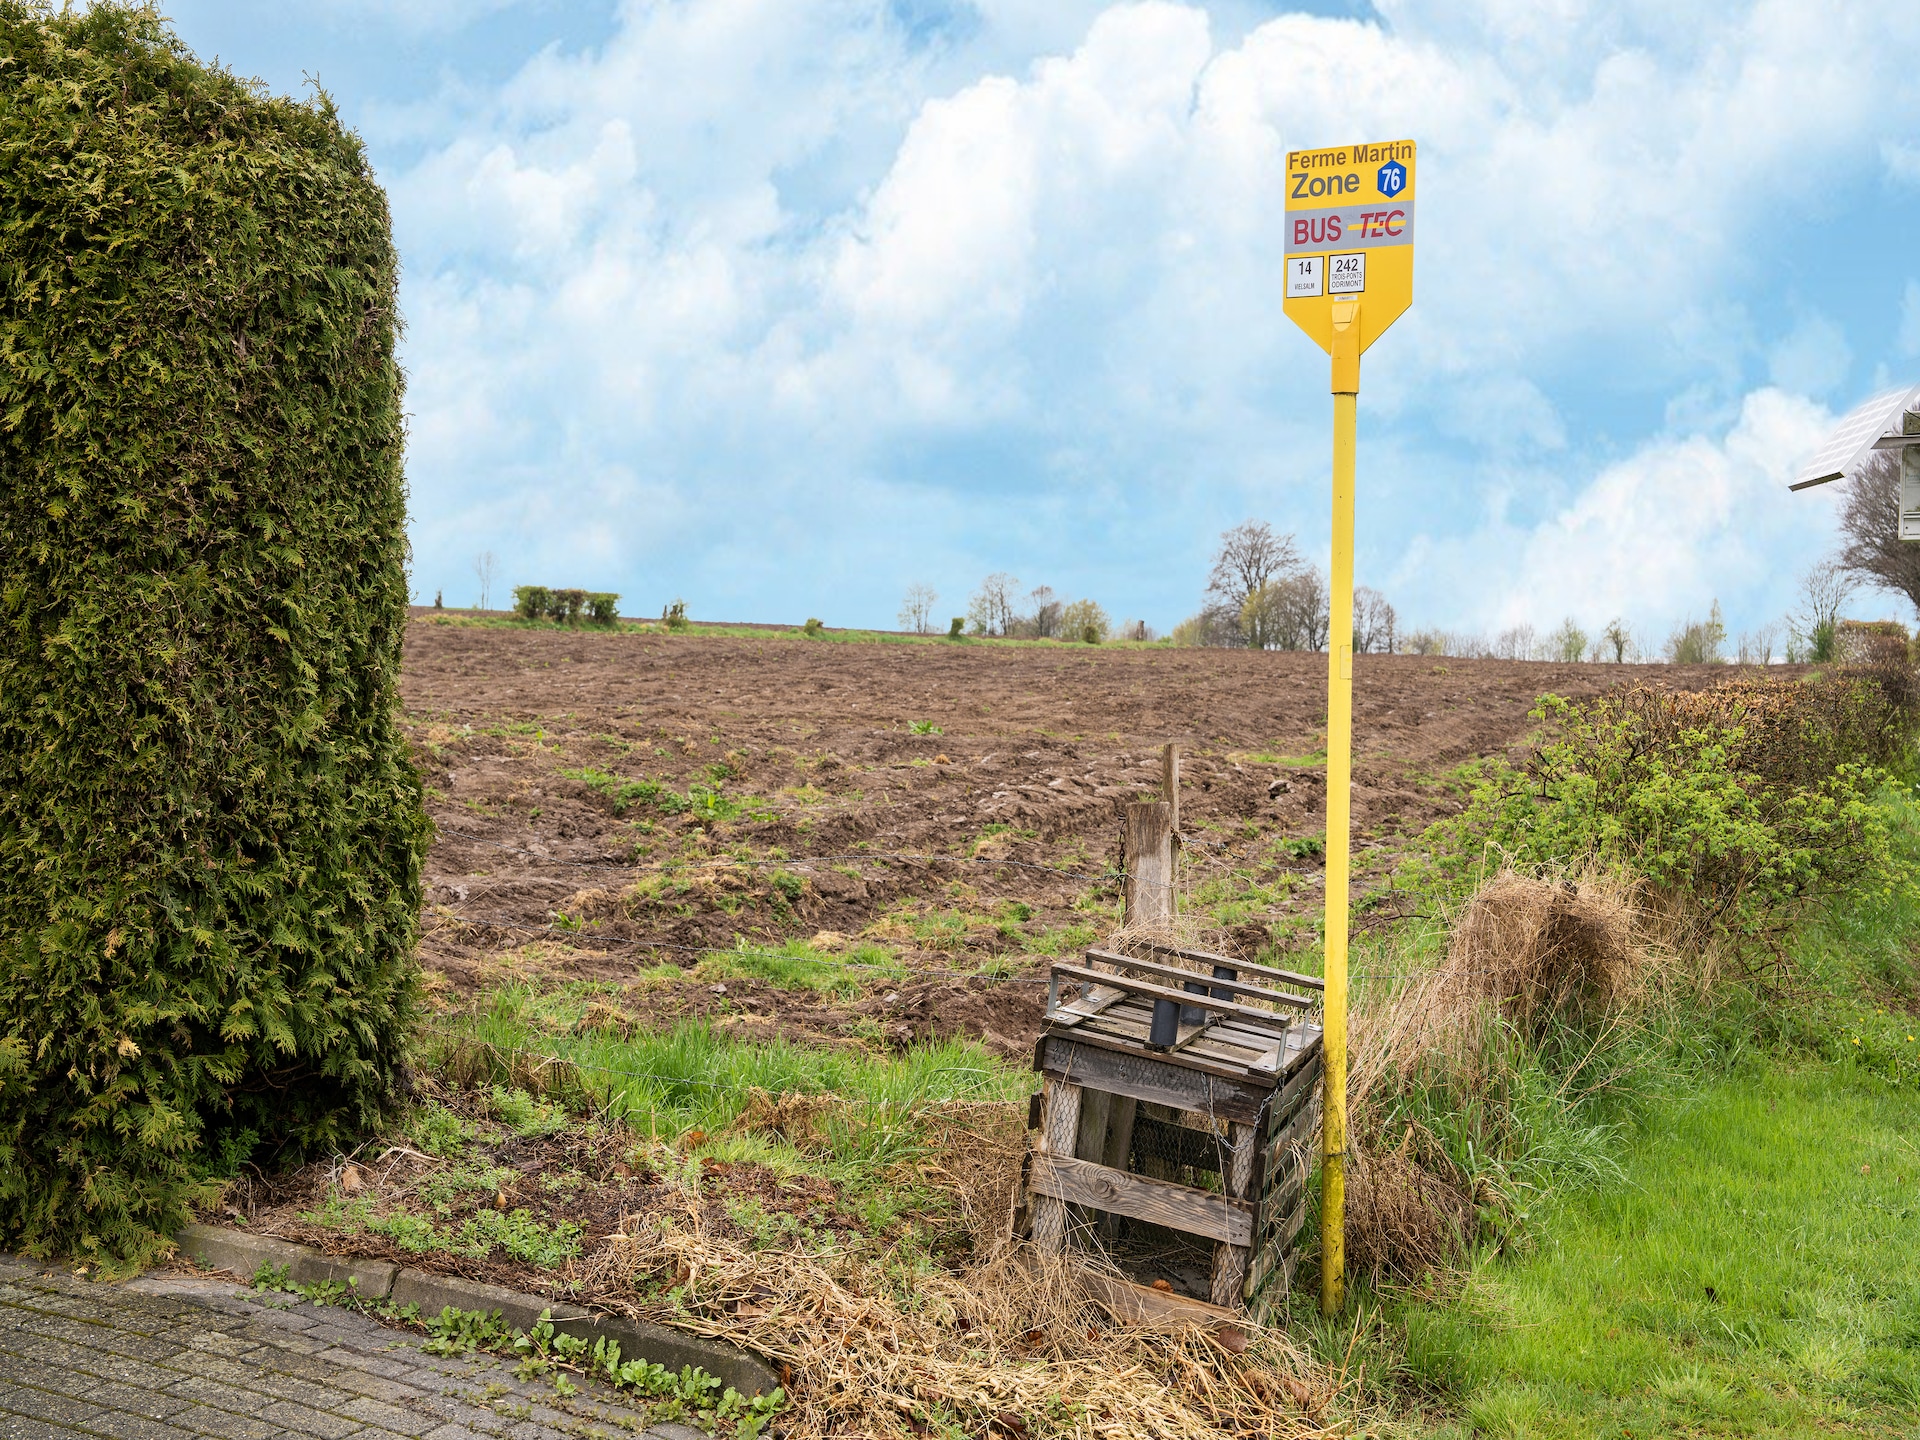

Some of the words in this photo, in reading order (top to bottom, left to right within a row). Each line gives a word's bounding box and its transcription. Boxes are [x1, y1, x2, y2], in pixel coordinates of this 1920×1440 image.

[1289, 151, 1346, 170] Ferme
[1353, 142, 1412, 164] Martin
[1291, 172, 1360, 199] Zone
[1381, 167, 1401, 192] 76
[1294, 215, 1342, 245] BUS
[1360, 209, 1405, 239] TEC
[1299, 261, 1312, 275] 14
[1336, 258, 1358, 273] 242
